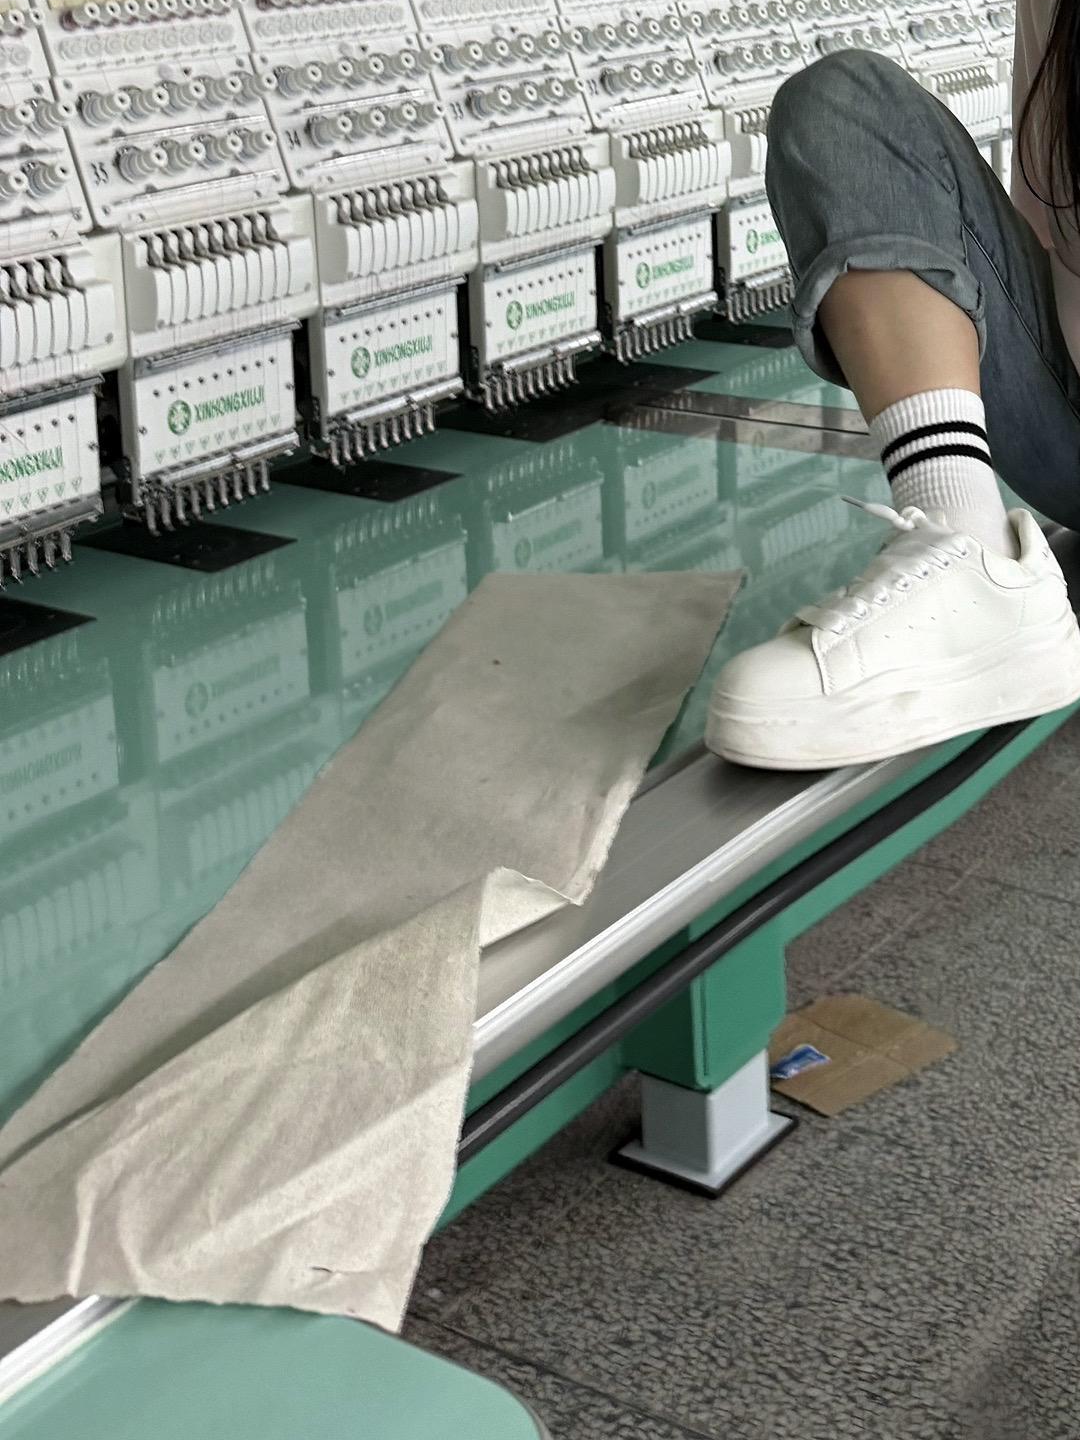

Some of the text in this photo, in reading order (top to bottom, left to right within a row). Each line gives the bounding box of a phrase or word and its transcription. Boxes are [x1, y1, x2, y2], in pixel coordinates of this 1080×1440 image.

[450, 102, 464, 121] 33
[285, 129, 302, 150] 34
[91, 161, 109, 186] 35
